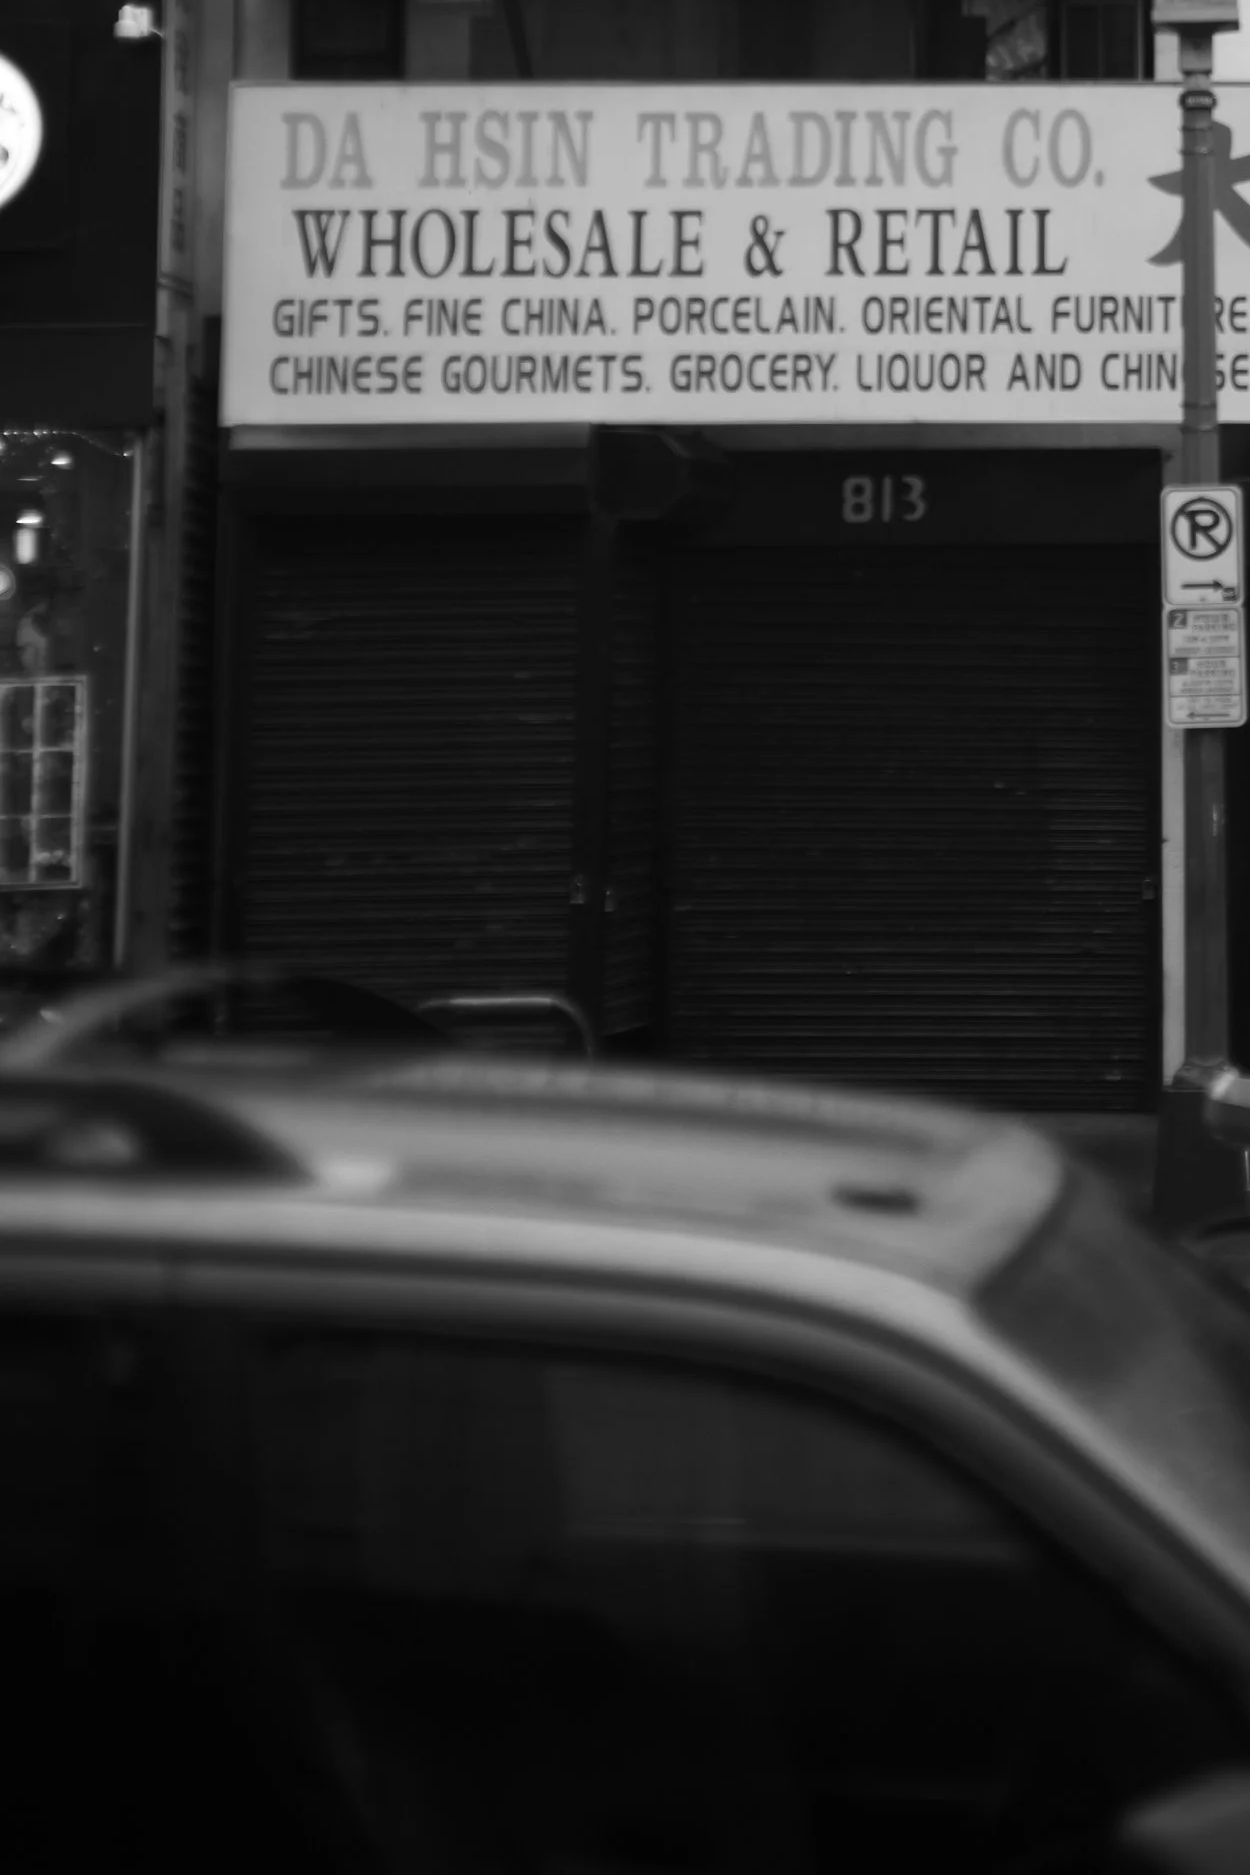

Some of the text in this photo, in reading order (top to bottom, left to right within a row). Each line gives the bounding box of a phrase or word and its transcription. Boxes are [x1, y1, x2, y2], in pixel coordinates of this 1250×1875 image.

[280, 107, 1105, 190] DA HSIN TRADING CO.
[291, 208, 1068, 280] WHOLESALE & RETAIL
[272, 296, 390, 339] GIFTS.
[402, 296, 484, 338] FINE
[500, 296, 617, 337] CHINA.
[633, 295, 846, 336] PORCELAIN.
[861, 295, 1033, 336] ORIENTAL
[268, 353, 424, 396] CHINESE
[440, 353, 651, 396] GOURMETS.
[669, 352, 839, 394] GROCERY.
[856, 352, 987, 394] LIQUOR
[1006, 352, 1083, 392] AND
[1100, 351, 1250, 392] CHINSE
[841, 474, 928, 525] 813
